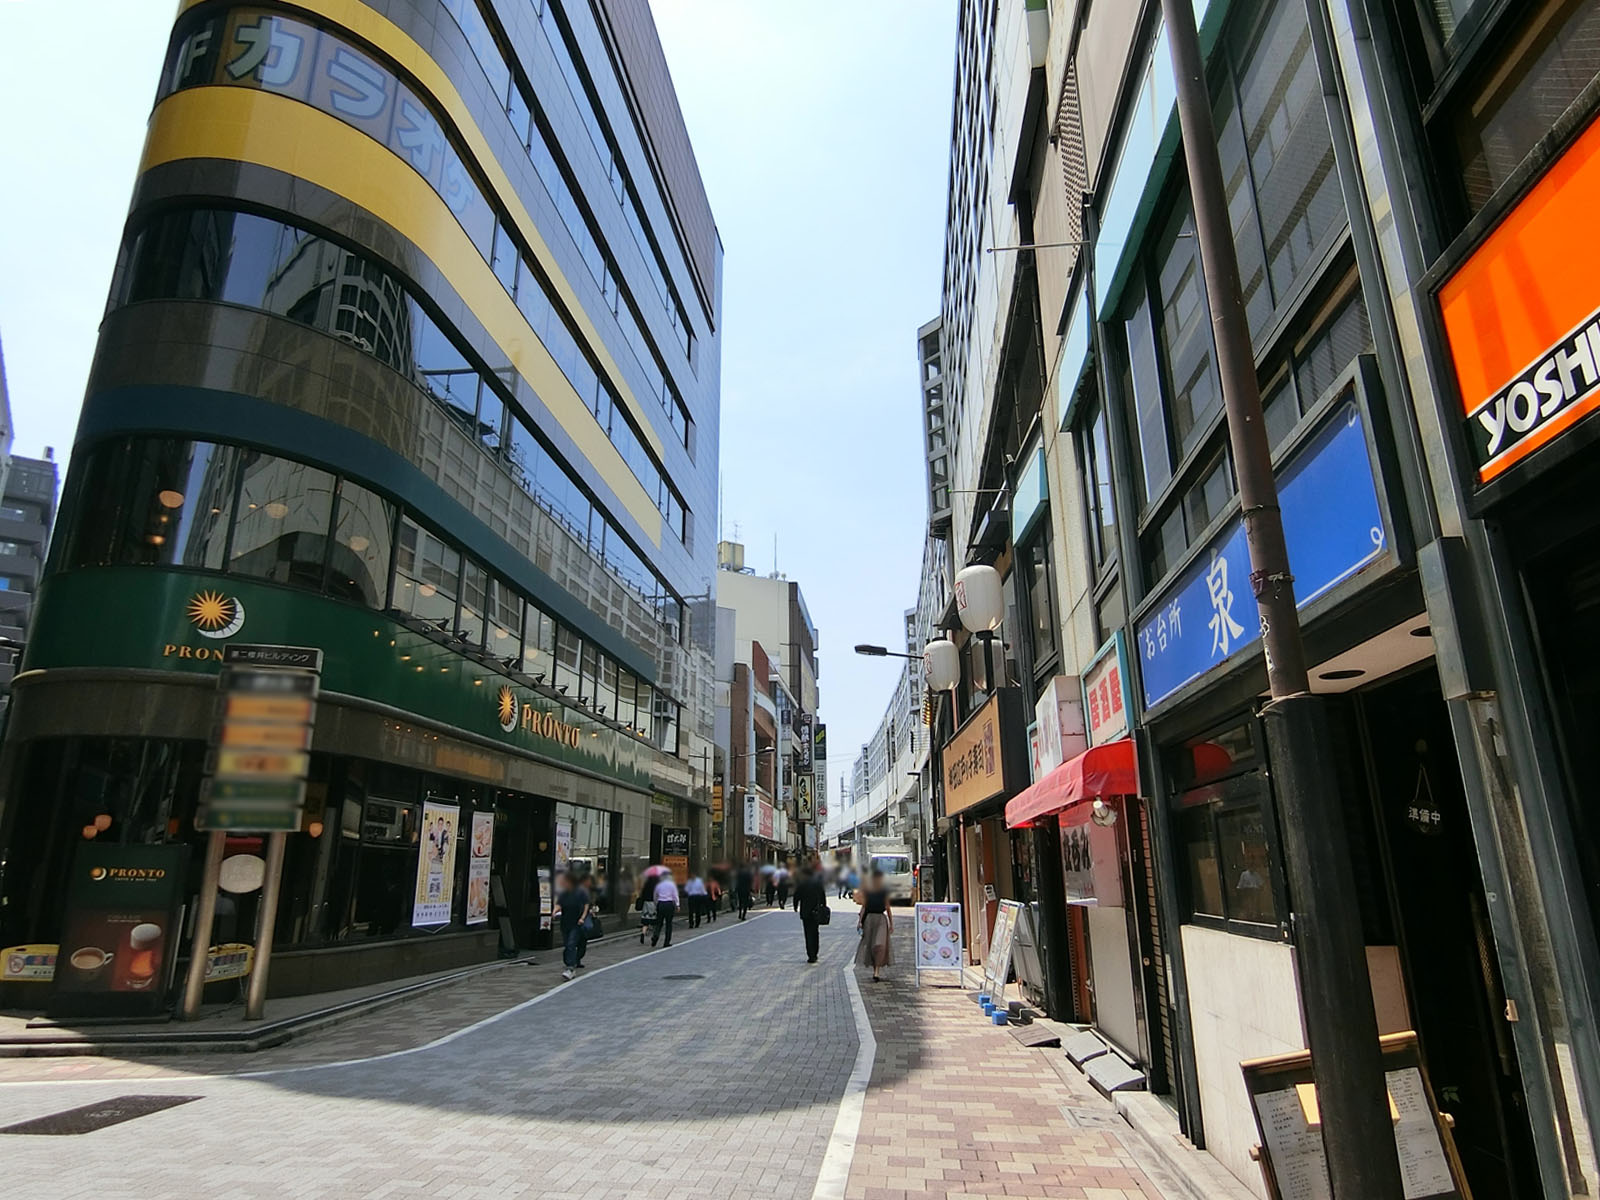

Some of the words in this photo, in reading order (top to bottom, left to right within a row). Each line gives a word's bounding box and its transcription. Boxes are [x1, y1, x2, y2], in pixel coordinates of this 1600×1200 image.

[1145, 598, 1182, 660] お台所
[1206, 547, 1244, 658] 泉
[162, 643, 223, 661] PRON
[1088, 666, 1123, 731] 居酒屋
[521, 705, 581, 749] PRONTO
[1408, 806, 1441, 825] 準備中
[109, 868, 166, 878] PRONTO
